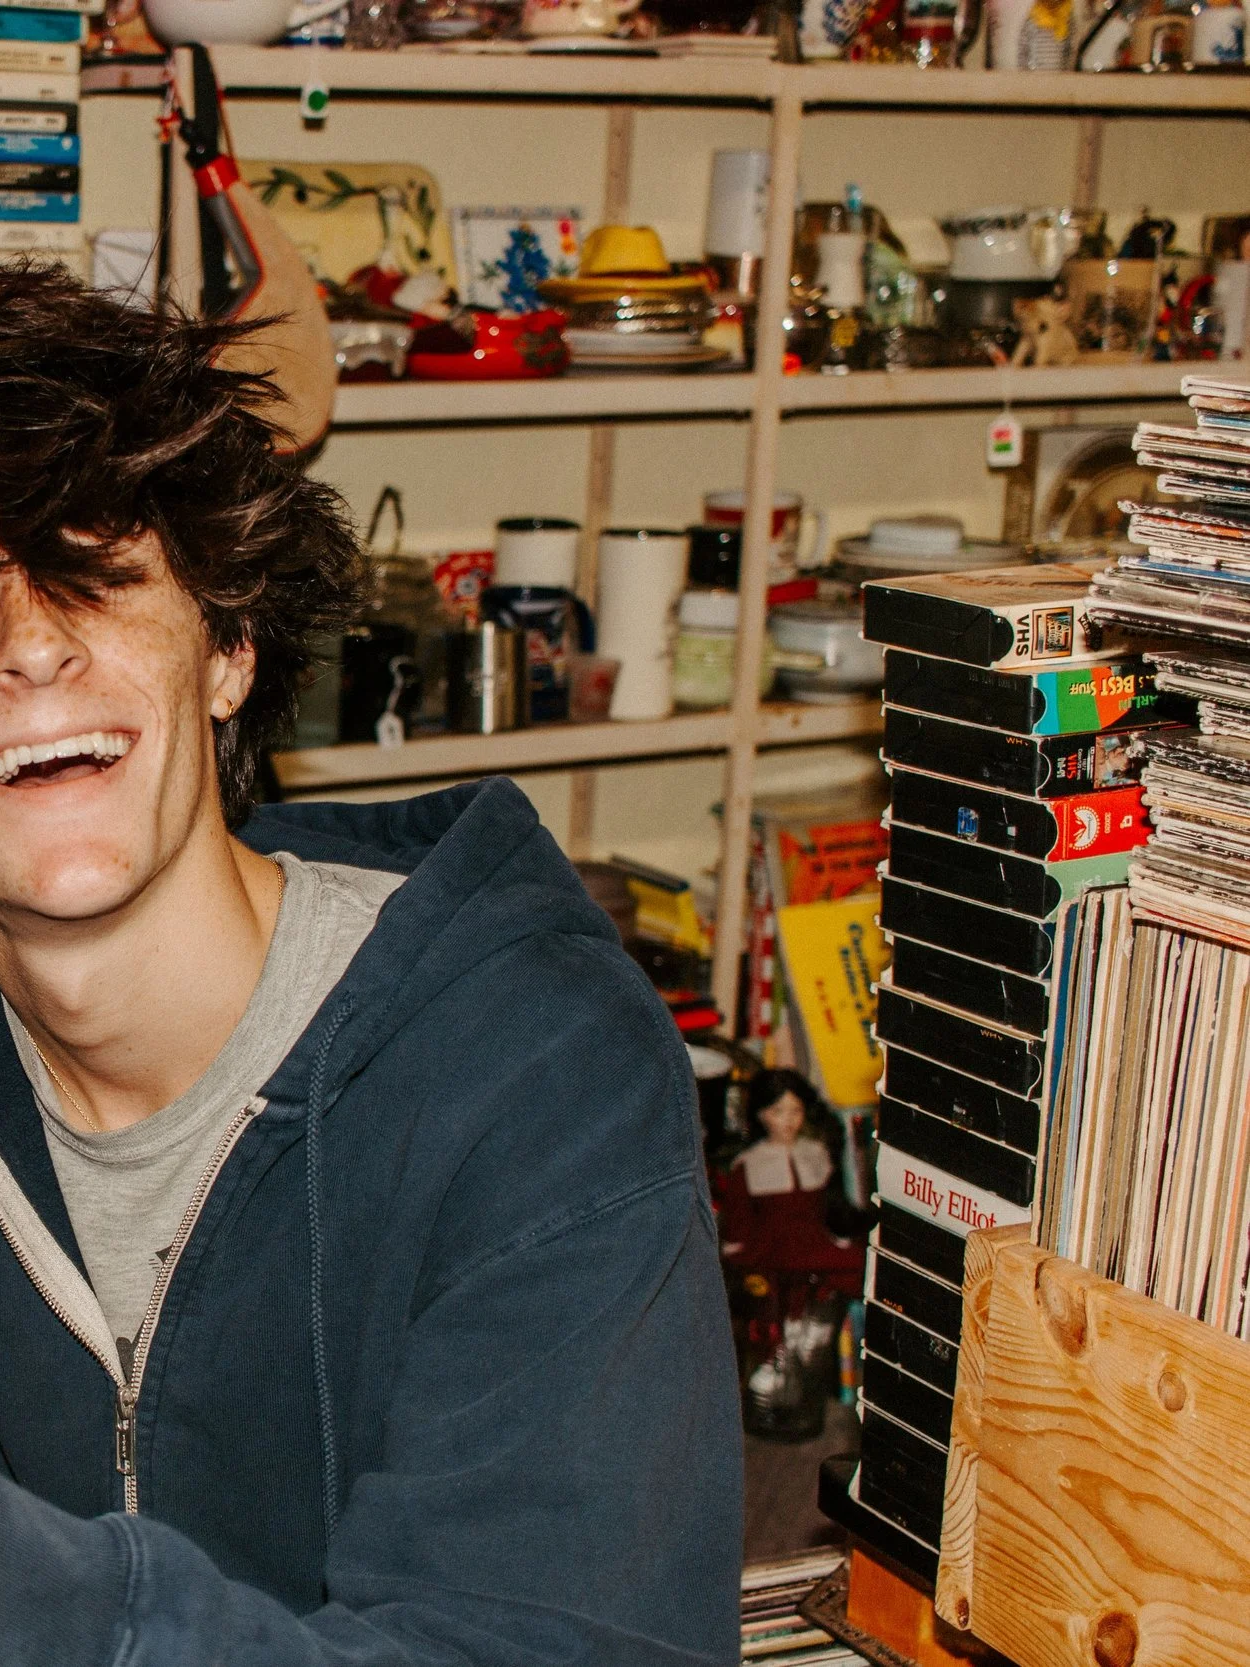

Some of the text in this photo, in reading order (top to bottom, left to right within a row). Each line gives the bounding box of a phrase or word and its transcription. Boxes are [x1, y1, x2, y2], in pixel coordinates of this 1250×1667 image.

[1015, 614, 1030, 657] VHS
[1100, 674, 1135, 697] BEST
[1067, 753, 1078, 780] VHS
[903, 1168, 998, 1230] Billy Elliot
